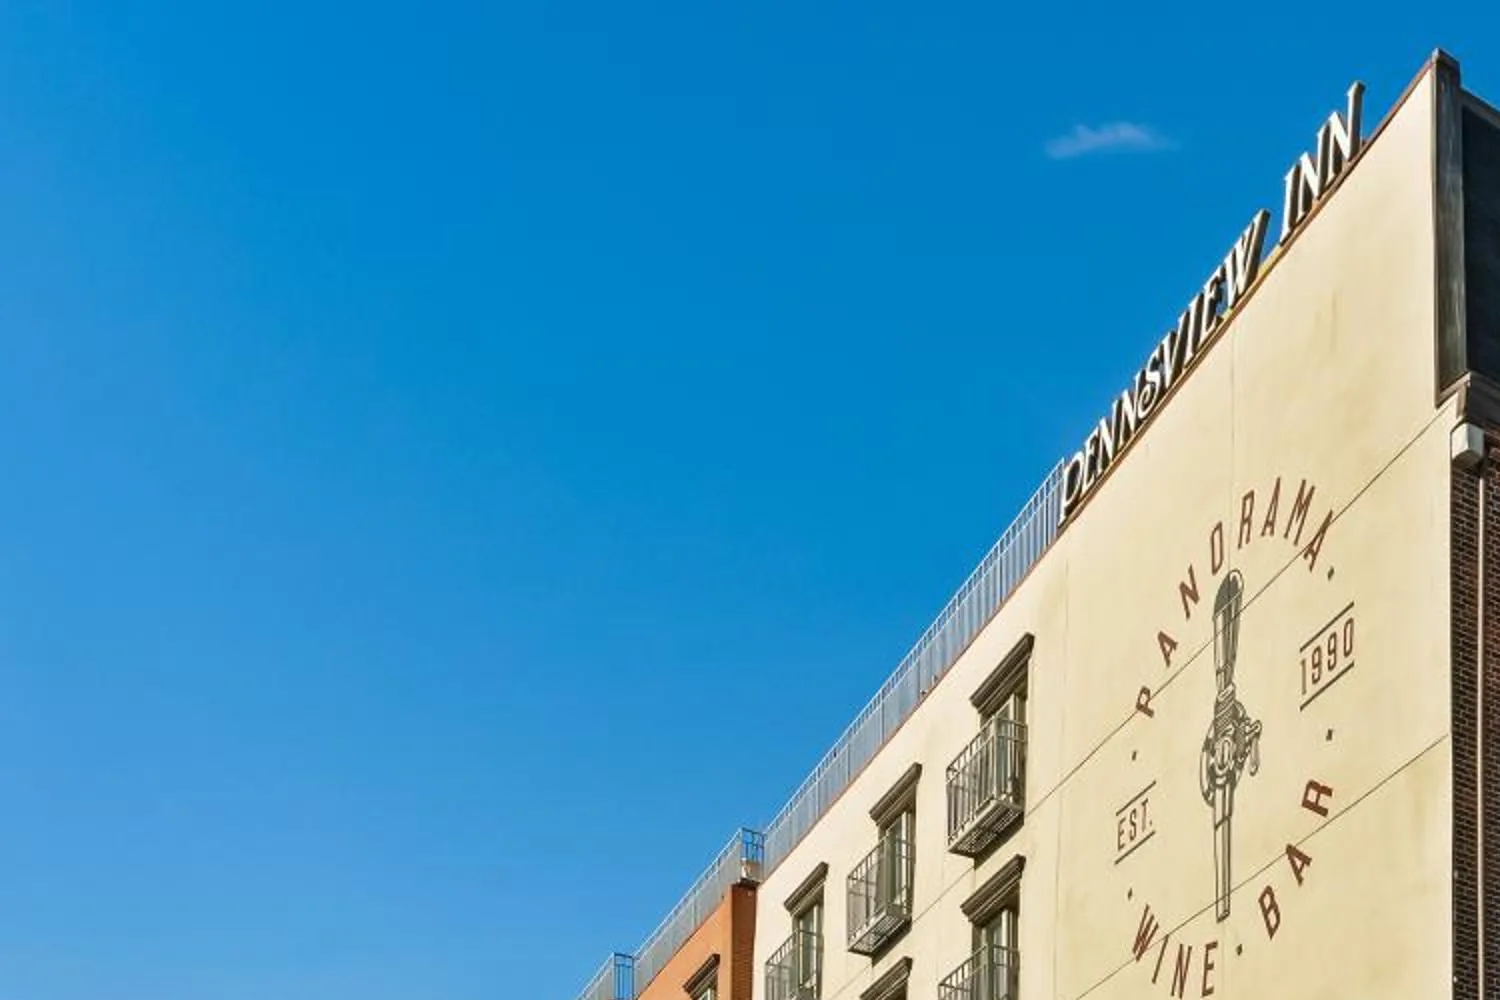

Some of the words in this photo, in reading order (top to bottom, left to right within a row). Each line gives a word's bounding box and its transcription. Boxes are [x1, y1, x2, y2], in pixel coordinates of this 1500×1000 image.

[1280, 80, 1366, 247] INN
[1136, 477, 1335, 717] PANORAMA
[1300, 617, 1356, 696] 1990
[1115, 798, 1155, 851] EST.
[1133, 903, 1219, 1000] WINE
[1257, 778, 1335, 939] BAR
